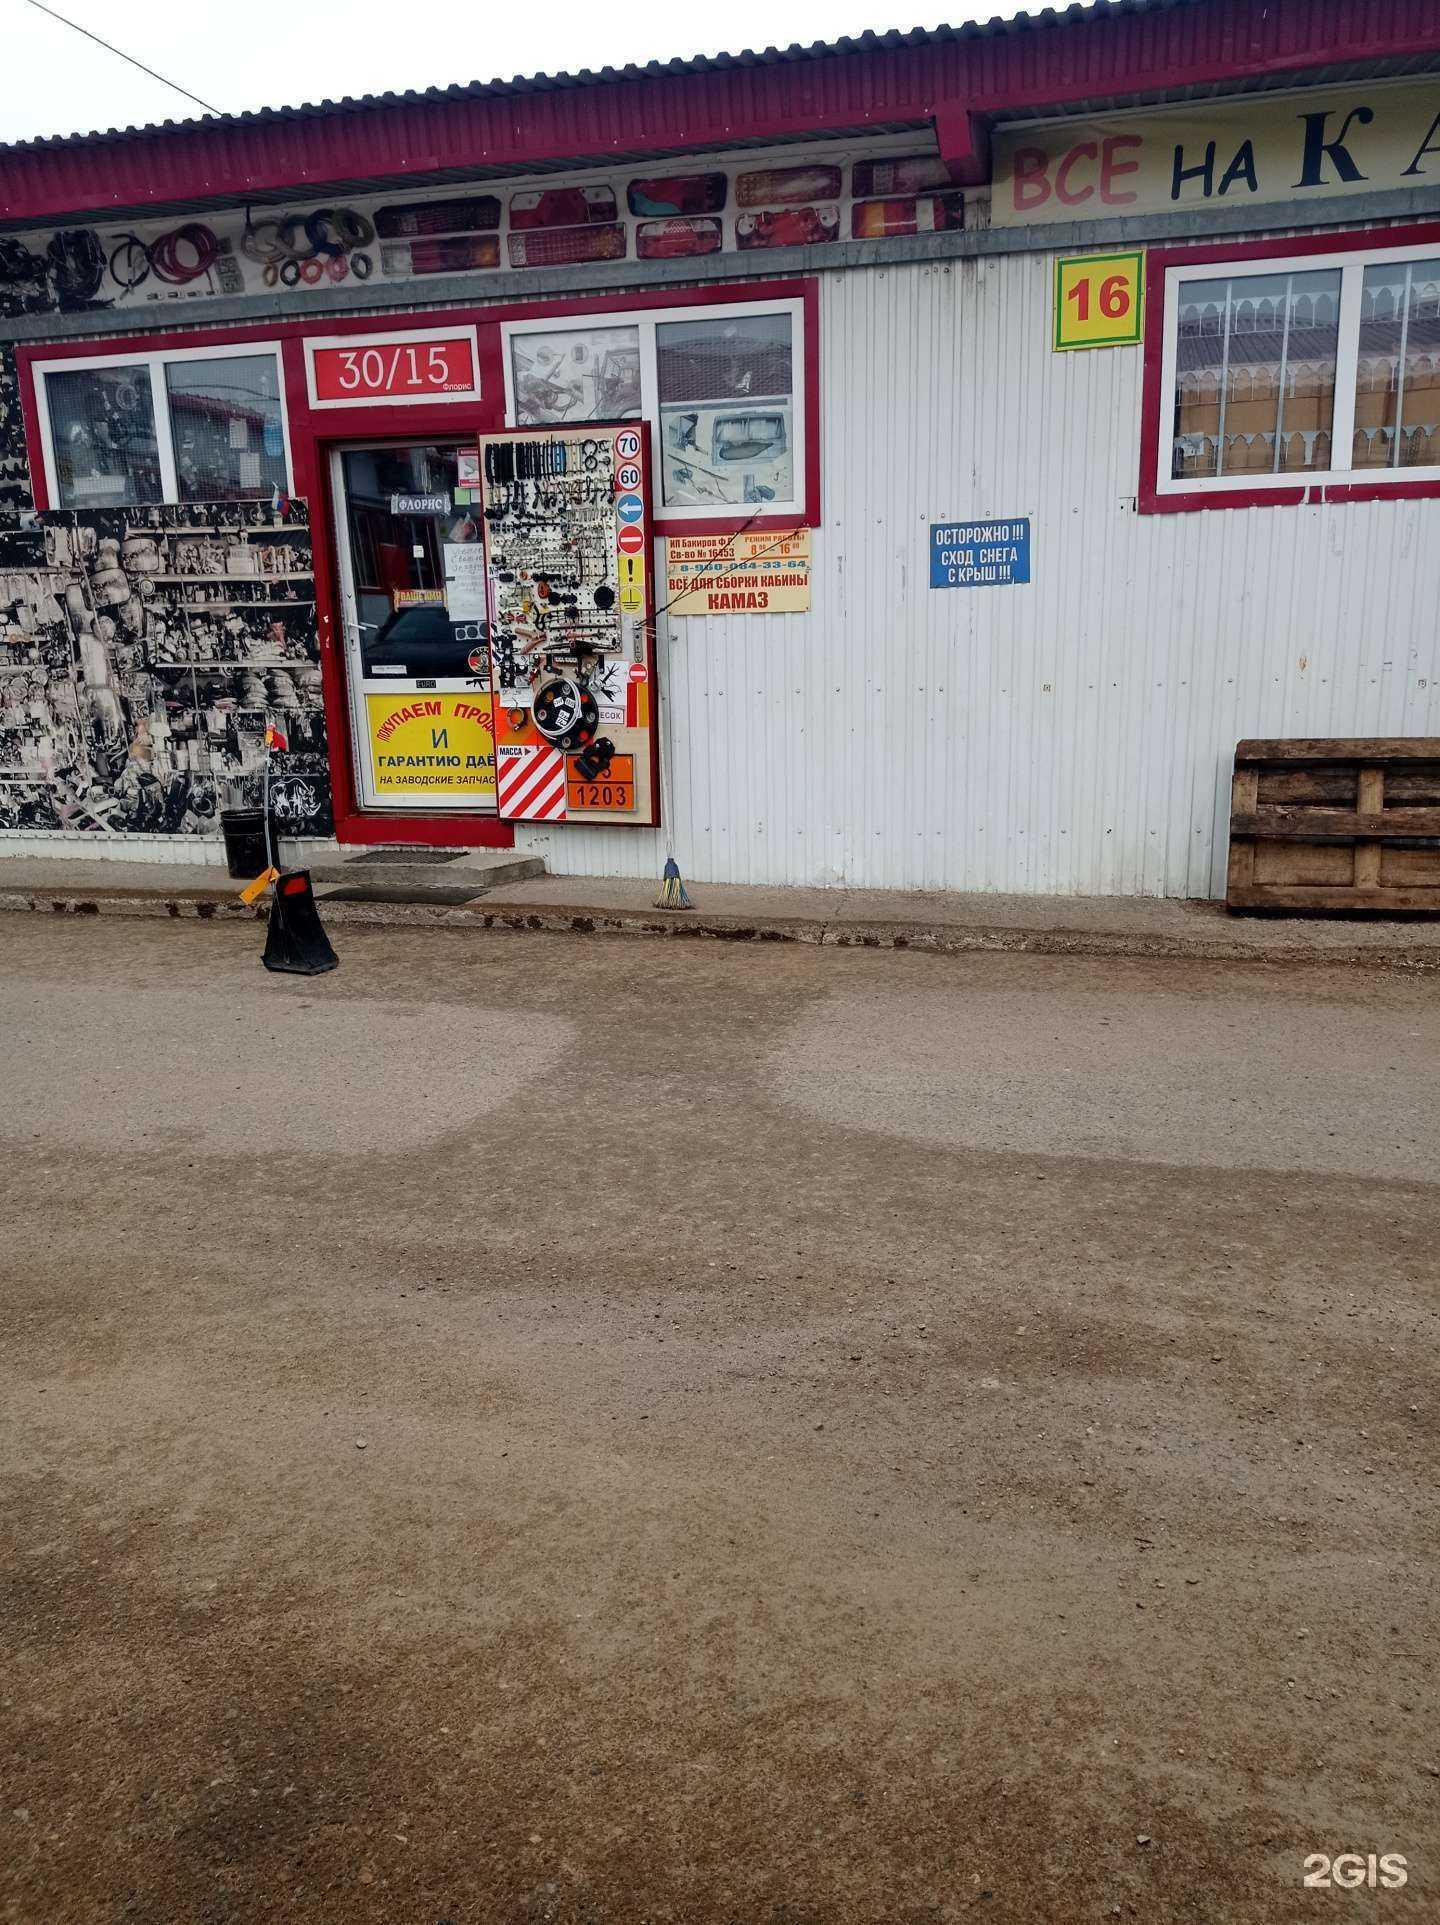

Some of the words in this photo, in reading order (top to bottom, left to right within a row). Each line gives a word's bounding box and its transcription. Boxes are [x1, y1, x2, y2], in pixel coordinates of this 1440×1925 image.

[1013, 134, 1143, 211] ВСЕ
[1171, 139, 1258, 201] НА
[1067, 275, 1131, 322] 16
[338, 346, 449, 390] 30/15
[442, 382, 472, 391] Флорис
[619, 437, 638, 452] 70
[620, 469, 639, 484] 60
[398, 498, 443, 511] ФЛОРИС
[670, 539, 681, 548] ИП
[682, 538, 717, 548] Бакиров
[936, 525, 1009, 545] ОСТОРОЖНО
[1012, 525, 1024, 540] !!!
[670, 550, 695, 559] Св-во
[942, 550, 974, 566] СХОД
[980, 547, 1018, 563] СНЕГА
[948, 569, 956, 582] С
[958, 566, 996, 582] КРЫШ
[999, 565, 1011, 580] !!!
[669, 576, 688, 590] ВСЁ
[690, 575, 713, 591] ДЛЯ
[716, 575, 758, 589] СБОРКИ
[761, 574, 808, 588] КАБИНЫ
[708, 591, 769, 609] КАМАЗ
[376, 701, 443, 743] ПОКУПАЕМ
[431, 728, 449, 748] И
[499, 746, 523, 756] МАССА
[378, 756, 461, 767] ГАРАНТИЮ
[379, 776, 393, 785] НА
[396, 775, 454, 786] ЗАВОДСКИЕ
[577, 785, 626, 806] 1203
